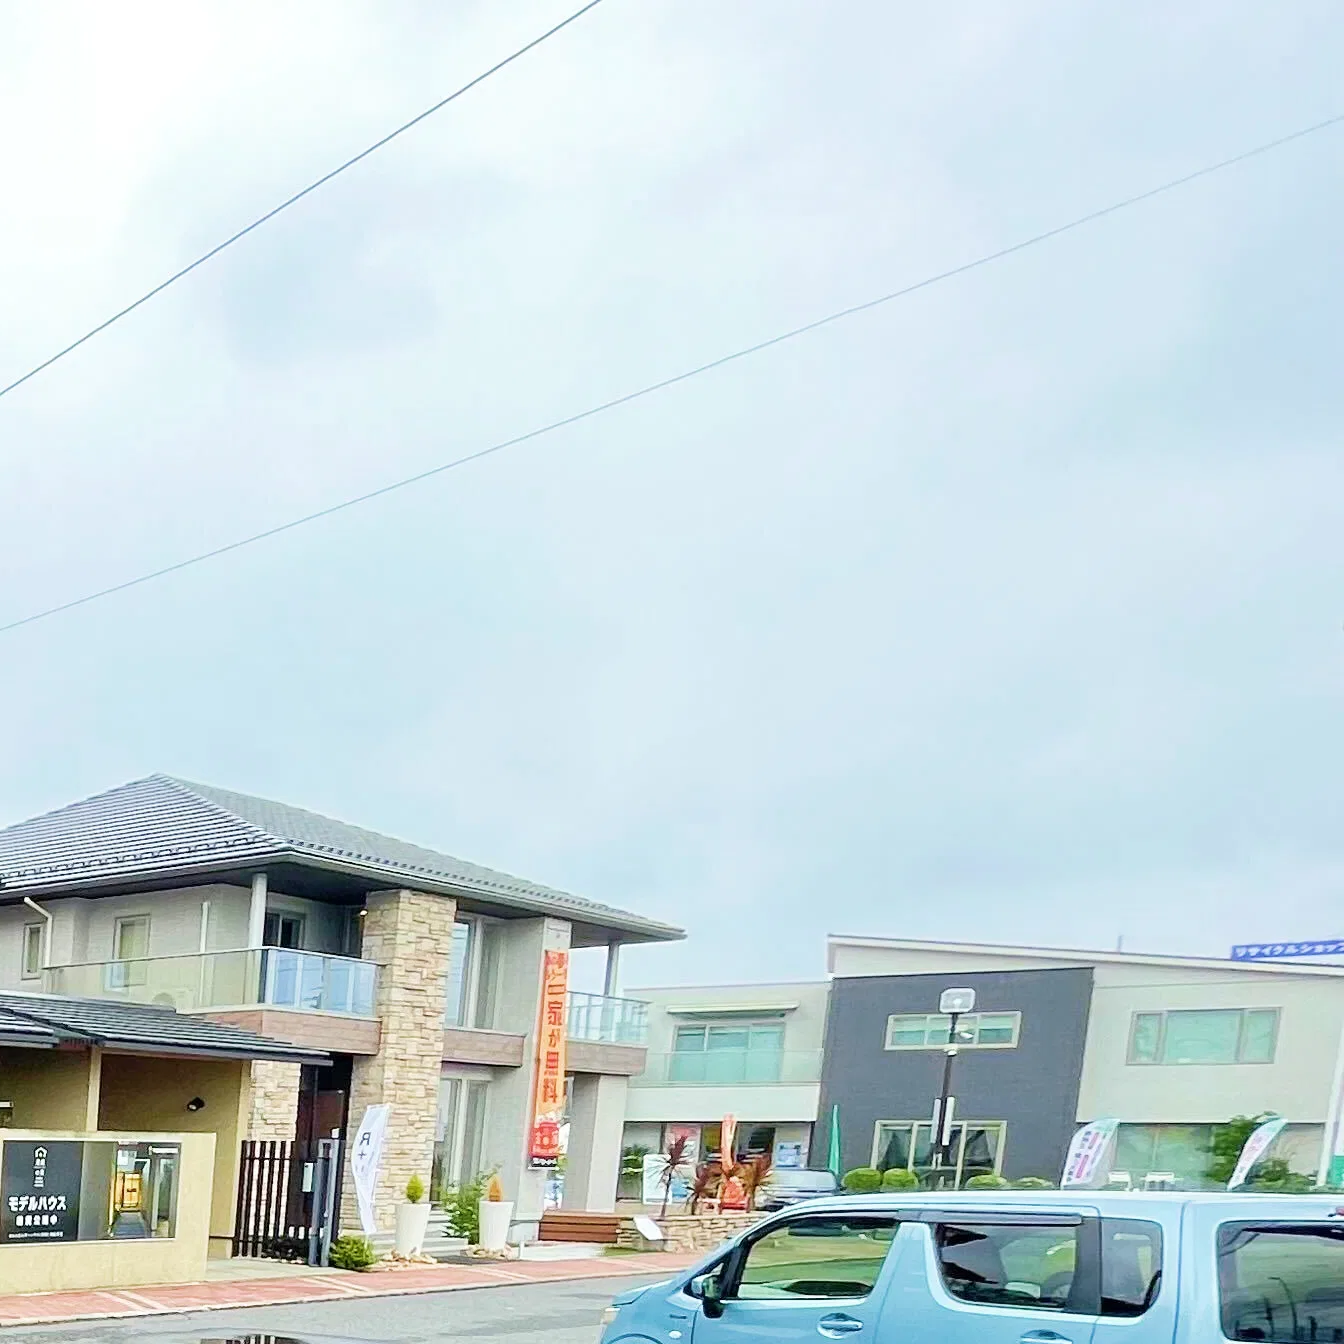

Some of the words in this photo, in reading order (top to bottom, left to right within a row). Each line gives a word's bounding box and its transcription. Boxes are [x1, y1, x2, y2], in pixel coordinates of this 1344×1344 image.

[8, 1195, 67, 1212] モデルハウス
